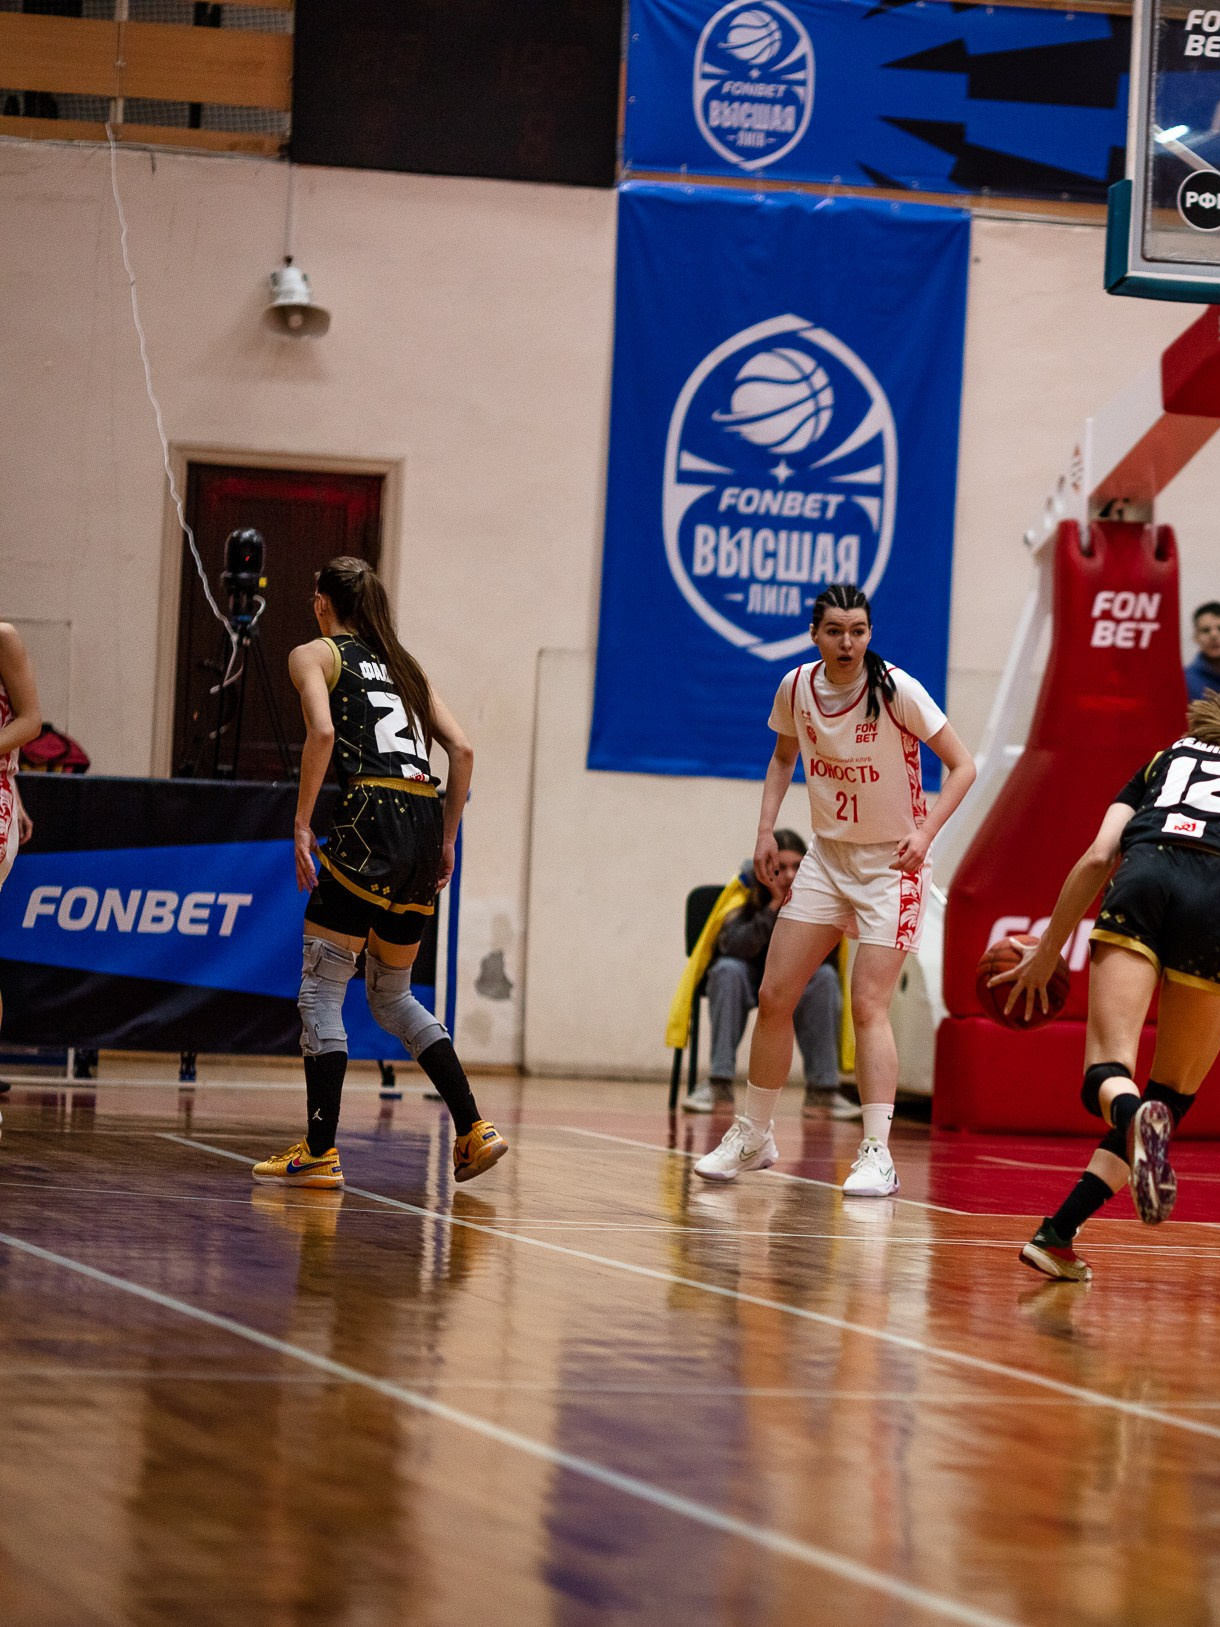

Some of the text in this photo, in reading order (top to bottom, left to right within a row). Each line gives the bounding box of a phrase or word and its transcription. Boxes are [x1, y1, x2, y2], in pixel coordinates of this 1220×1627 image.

[718, 487, 846, 520] FONBET
[693, 523, 861, 585] ВЫСШАЯ
[746, 583, 801, 616] ЛИГА
[1091, 590, 1162, 619] FON
[1090, 620, 1161, 649] BET
[855, 722, 877, 733] FON
[855, 733, 878, 743] BET
[810, 758, 880, 784] ЮНОСТЬ
[835, 791, 858, 823] 21
[22, 885, 253, 937] FONBET
